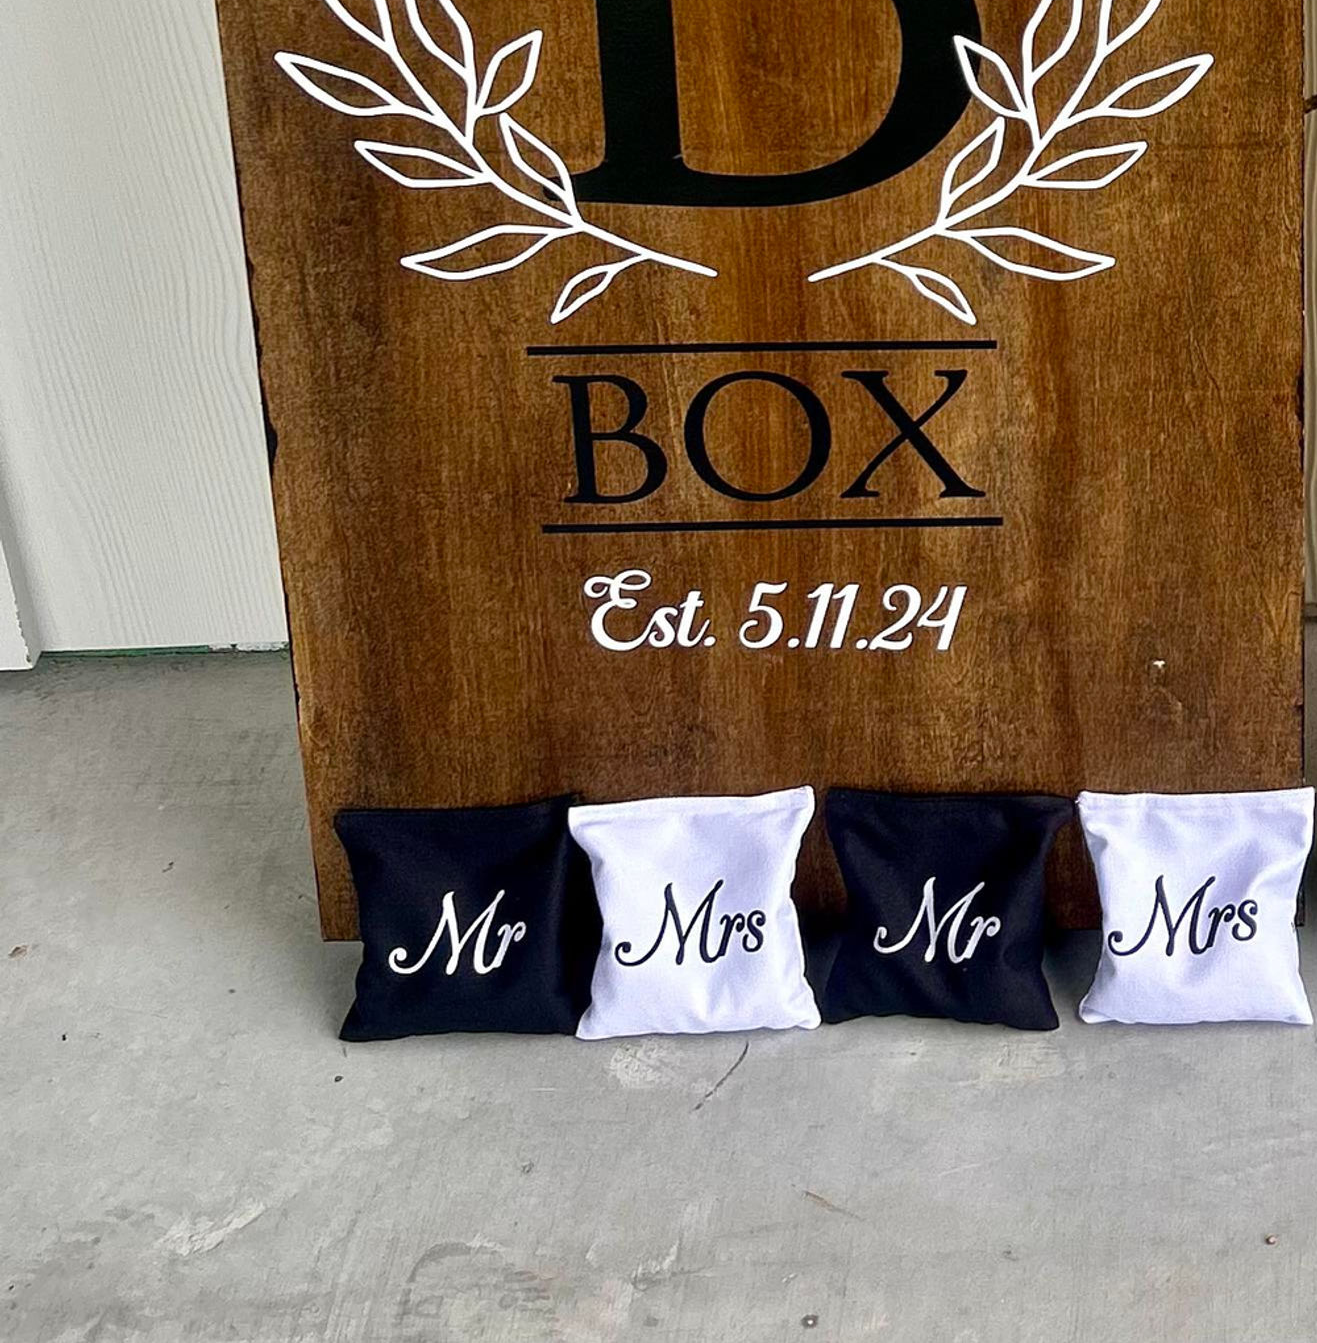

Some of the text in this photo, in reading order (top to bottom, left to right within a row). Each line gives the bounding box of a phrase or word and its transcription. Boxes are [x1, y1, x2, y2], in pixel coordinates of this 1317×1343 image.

[552, 369, 986, 503] BOX
[583, 569, 967, 651] Est. 5.11.24
[388, 888, 526, 975] Mr
[614, 879, 765, 967] Mrs
[873, 876, 1001, 963] Mr
[1107, 875, 1259, 957] Mrs
